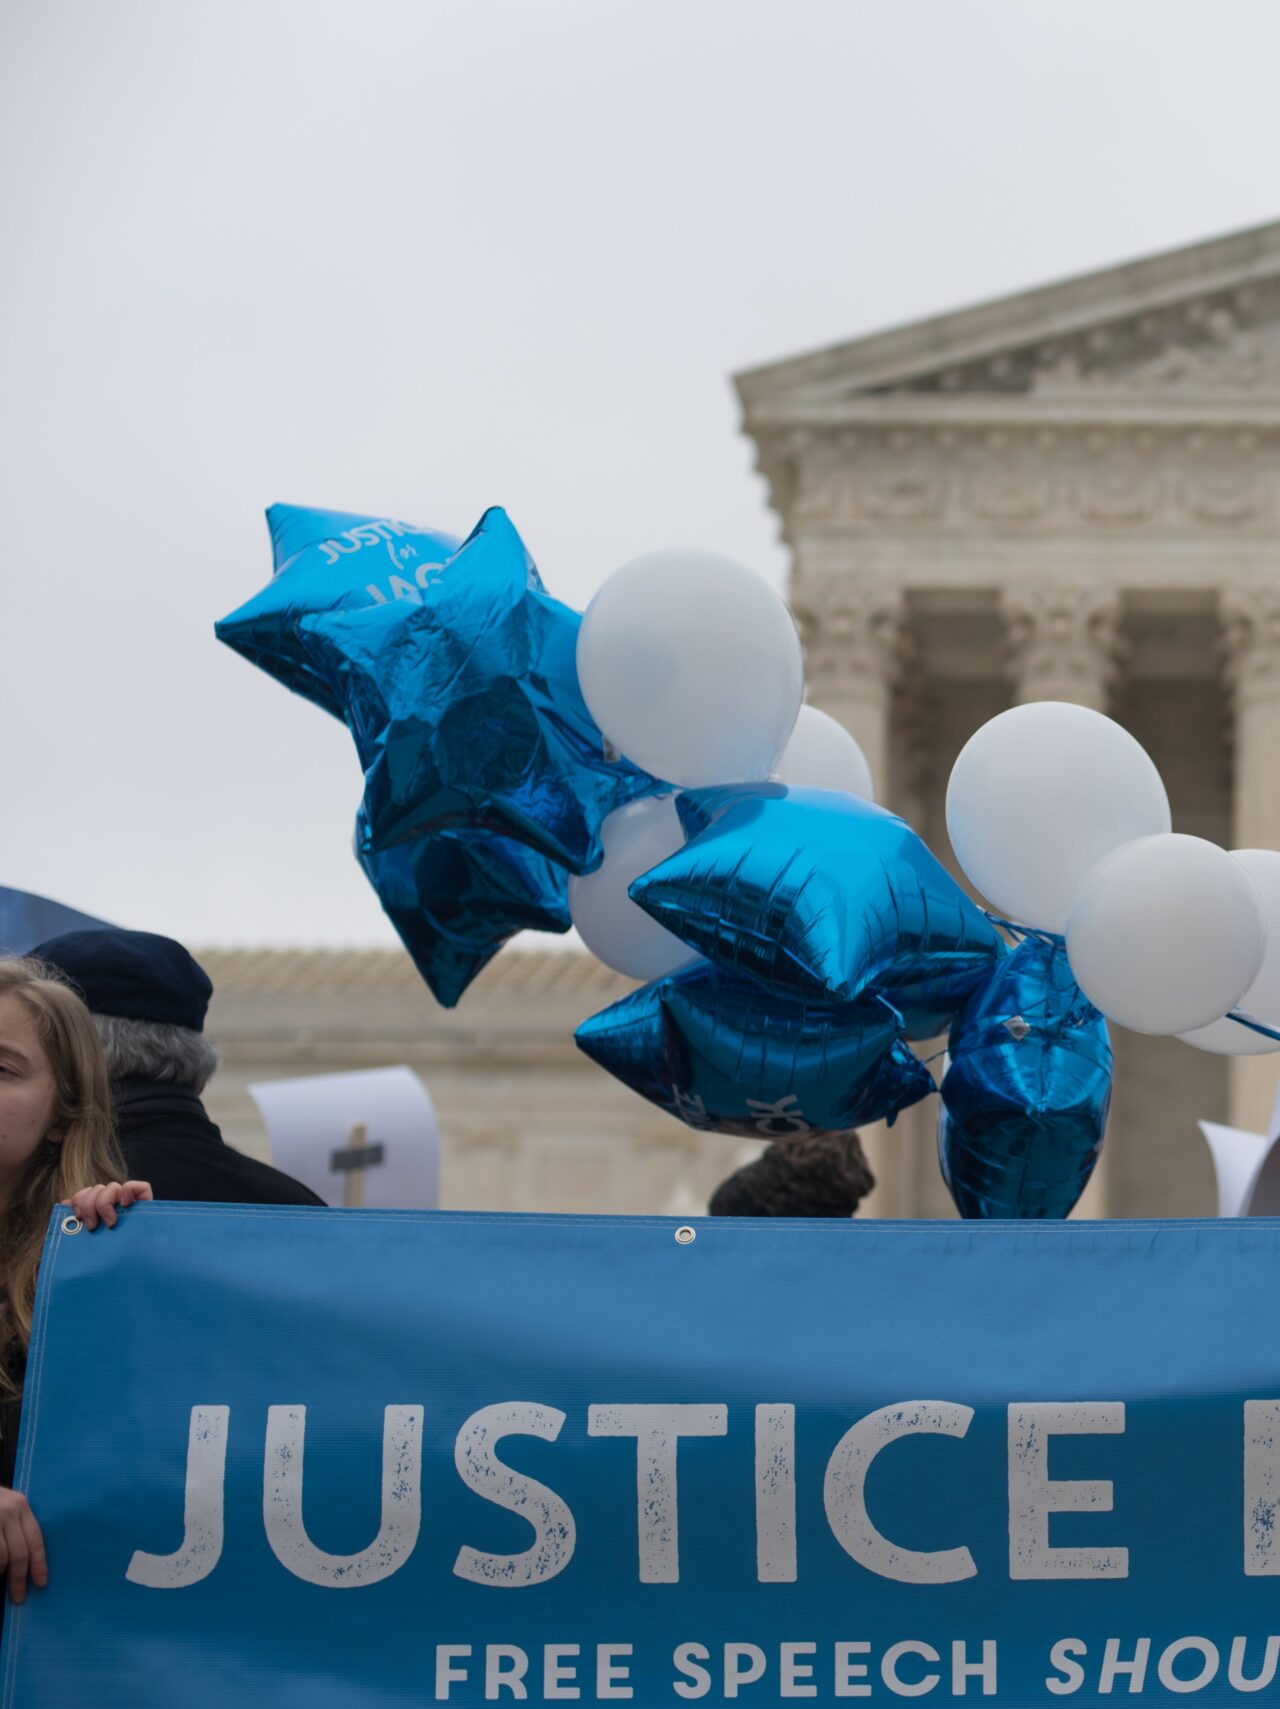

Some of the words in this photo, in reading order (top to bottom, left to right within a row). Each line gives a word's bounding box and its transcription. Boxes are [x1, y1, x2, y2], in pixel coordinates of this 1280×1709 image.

[366, 557, 456, 605] JAC
[386, 540, 420, 570] for
[126, 1400, 1129, 1588] JUSTICE
[435, 1643, 633, 1700] FREE
[673, 1640, 997, 1699] SPEECH
